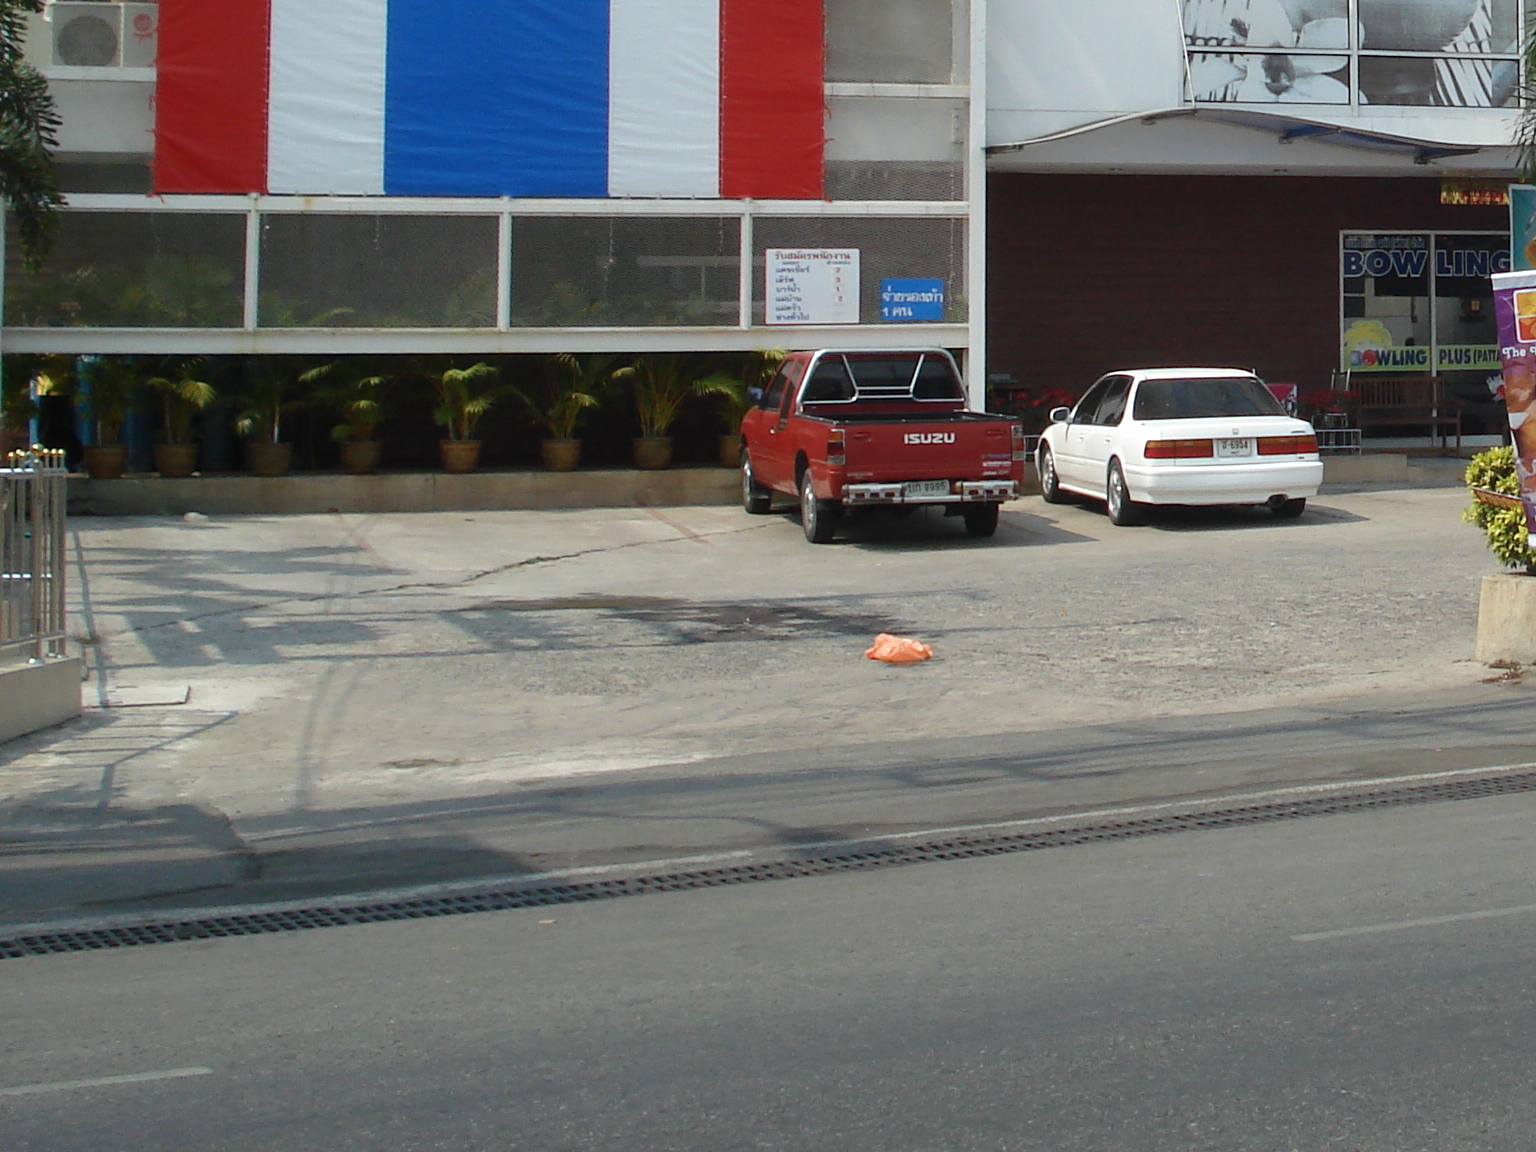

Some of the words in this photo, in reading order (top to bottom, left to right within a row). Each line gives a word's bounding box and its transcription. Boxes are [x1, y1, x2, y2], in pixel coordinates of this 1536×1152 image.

[1439, 348, 1471, 365] PLUS
[1502, 346, 1526, 360] The
[903, 432, 956, 444] ISUZU
